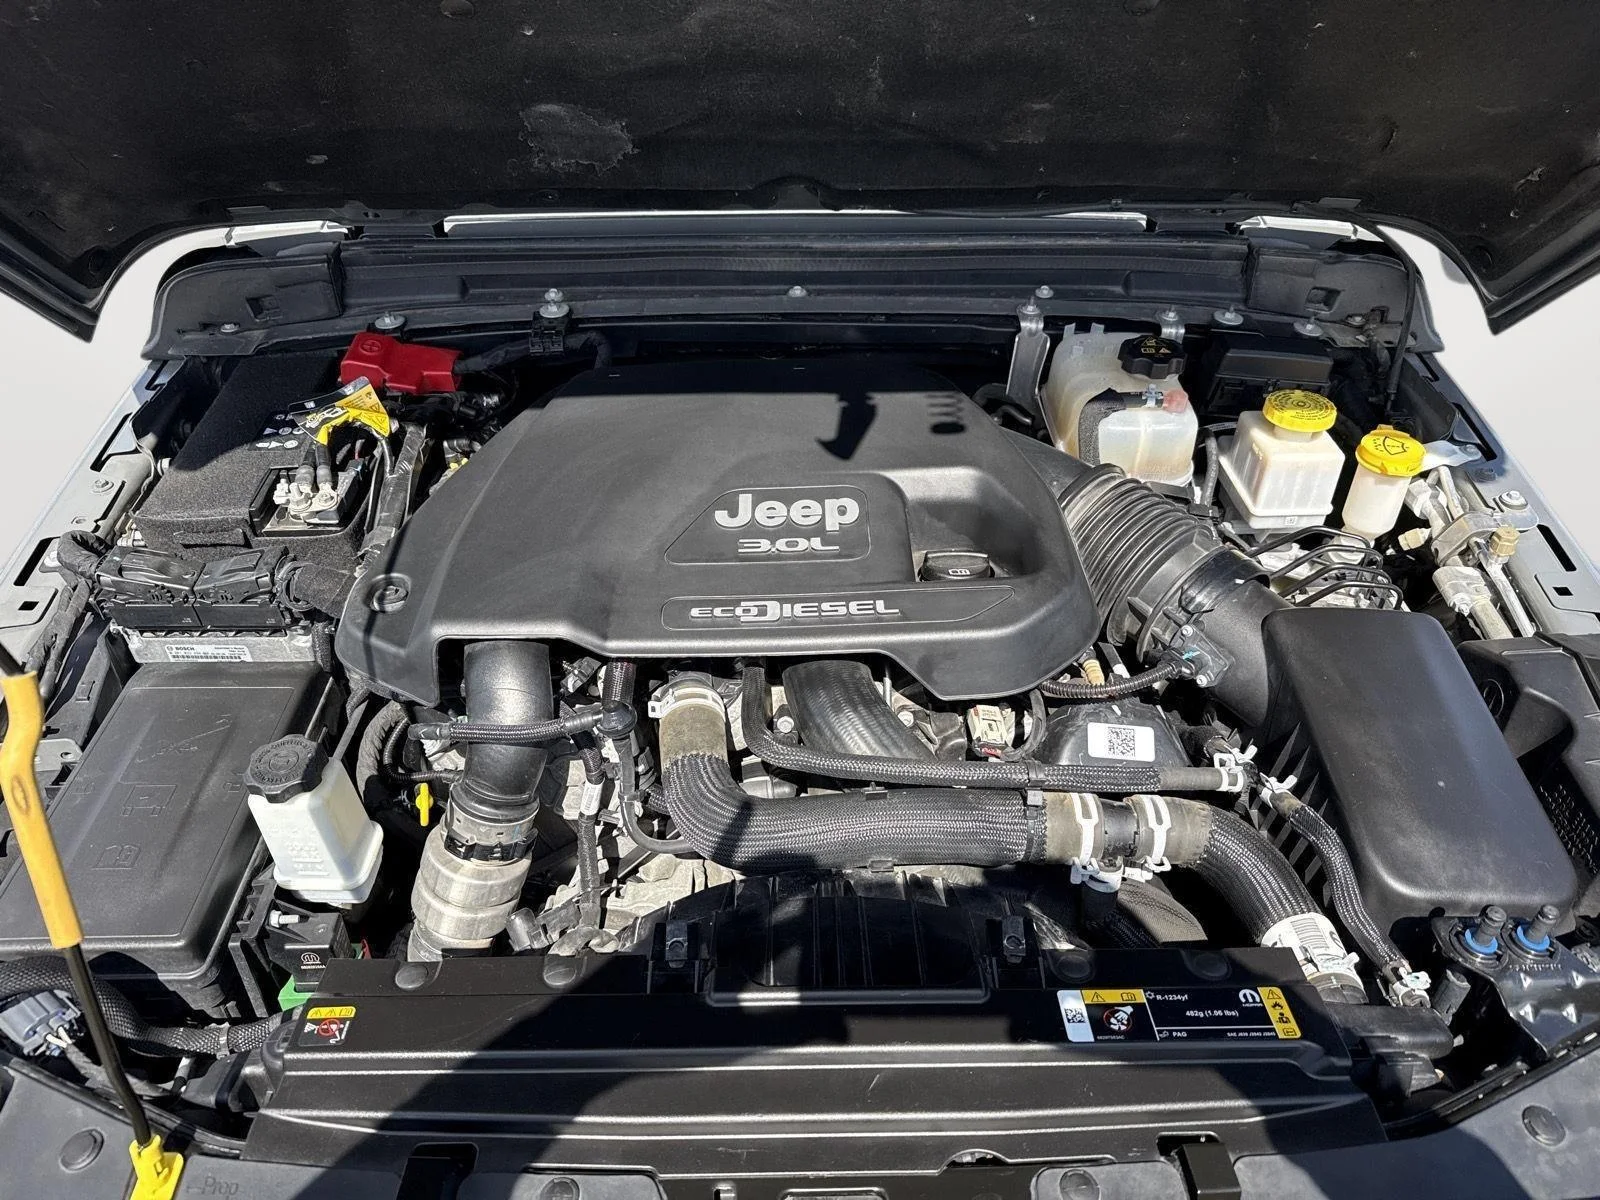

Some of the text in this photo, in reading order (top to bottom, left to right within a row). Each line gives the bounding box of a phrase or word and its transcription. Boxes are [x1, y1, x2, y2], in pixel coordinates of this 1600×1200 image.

[714, 493, 860, 532] Jeep
[737, 537, 840, 554] 3.0L
[1156, 994, 1189, 1002] R-1234yf
[1186, 1010, 1204, 1018] 482g
[1223, 1009, 1240, 1017] lbs)
